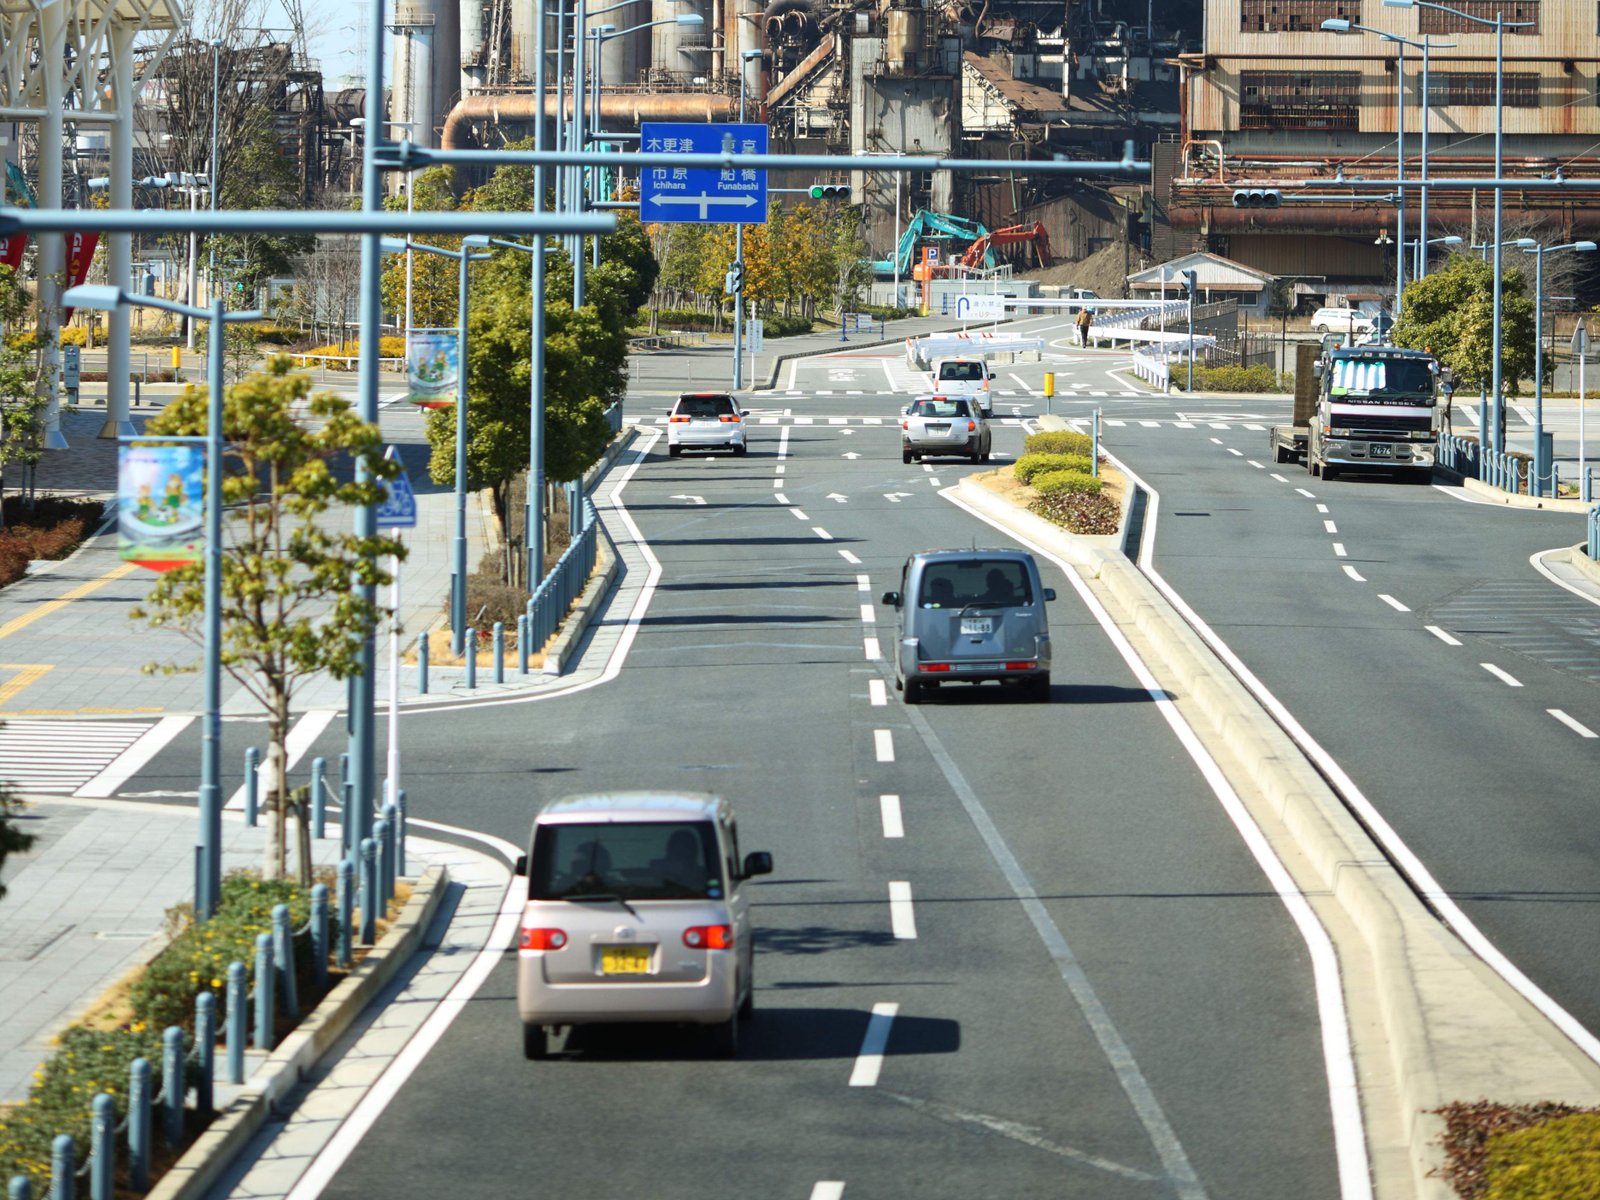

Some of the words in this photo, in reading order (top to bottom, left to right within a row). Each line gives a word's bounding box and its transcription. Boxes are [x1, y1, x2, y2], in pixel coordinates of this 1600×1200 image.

[646, 137, 694, 153] 木更津
[653, 181, 686, 190] Ichihara
[717, 182, 759, 191] Funabashi
[928, 250, 937, 259] P
